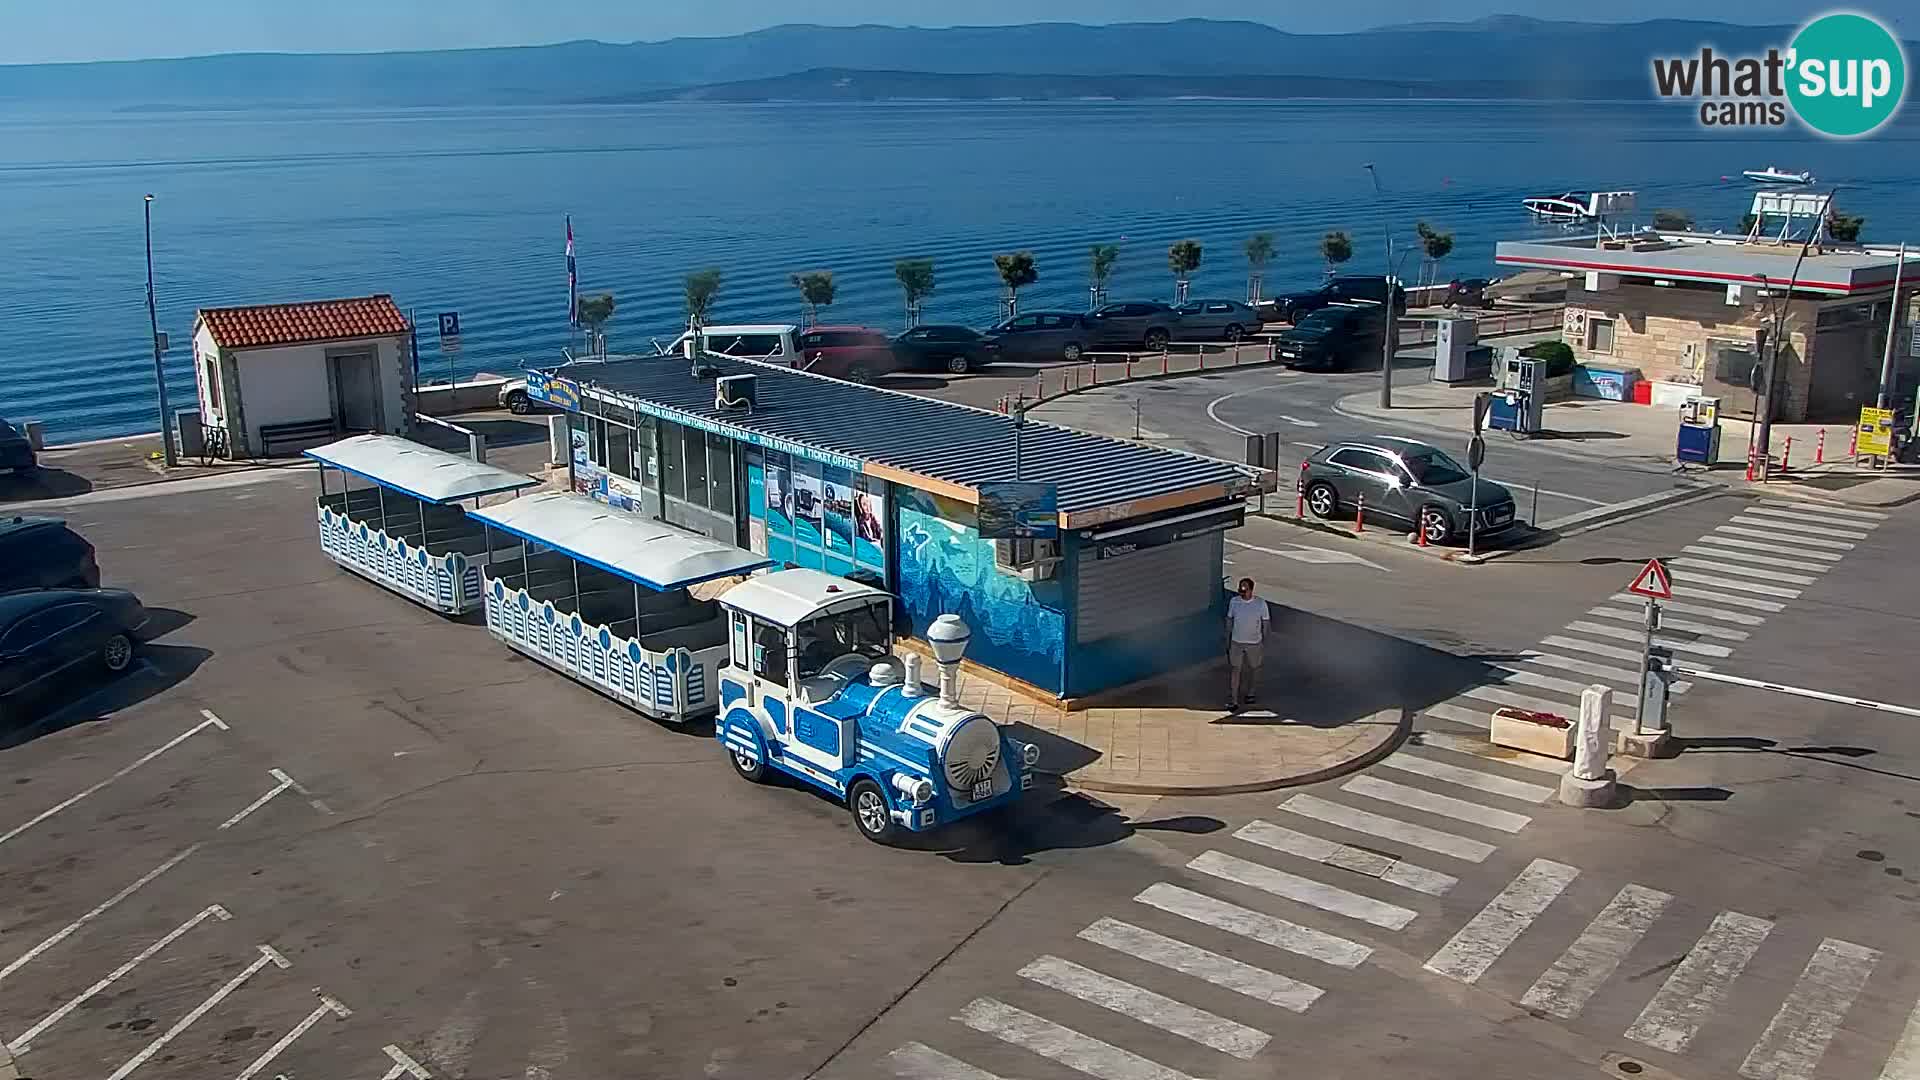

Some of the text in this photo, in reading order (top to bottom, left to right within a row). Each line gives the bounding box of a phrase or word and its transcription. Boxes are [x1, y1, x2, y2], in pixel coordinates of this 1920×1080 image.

[443, 315, 454, 333] P
[682, 413, 720, 433] AUTOBUSNA
[720, 424, 750, 441] POSTAJA
[759, 435, 774, 449] BUS
[774, 440, 805, 456] STATION
[806, 447, 832, 464] TICKET
[832, 455, 859, 470] OFFICE
